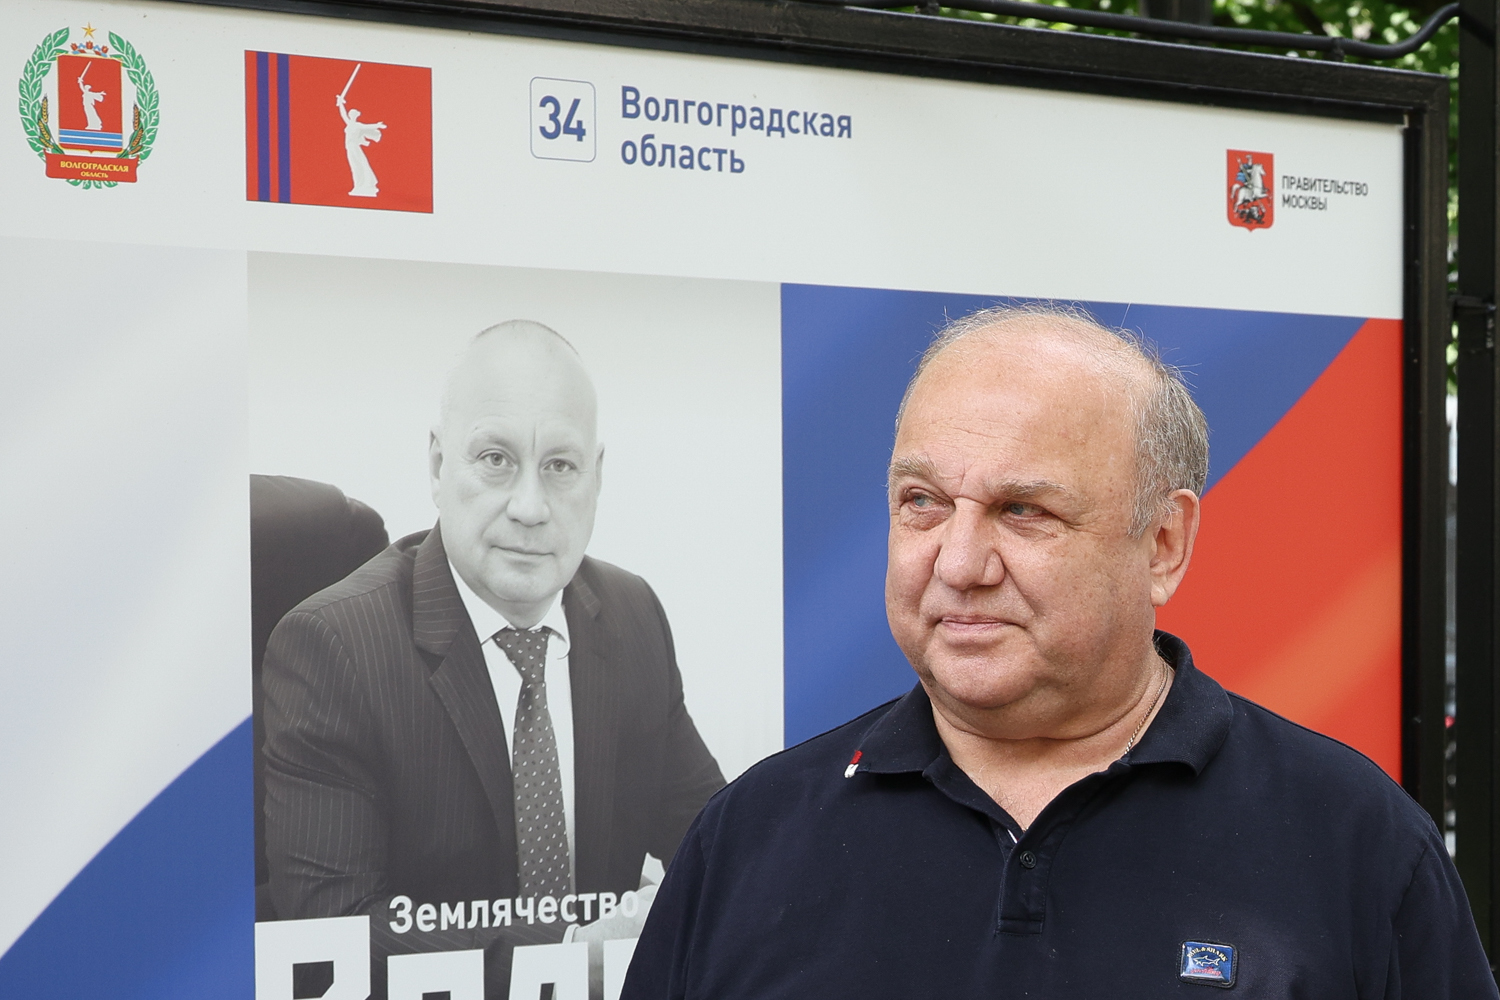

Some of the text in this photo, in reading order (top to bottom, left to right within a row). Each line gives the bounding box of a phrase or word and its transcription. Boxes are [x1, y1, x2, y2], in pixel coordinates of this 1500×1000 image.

[539, 94, 587, 144] 34
[620, 85, 853, 141] Волгоградская
[60, 160, 129, 172] ВОЛГОГРАДСКАЯ
[620, 137, 746, 176] область
[1281, 175, 1369, 196] ПРАВИТЕЛЬСТВО
[1281, 194, 1328, 211] МОСКВЫ
[389, 890, 640, 934] Землячество
